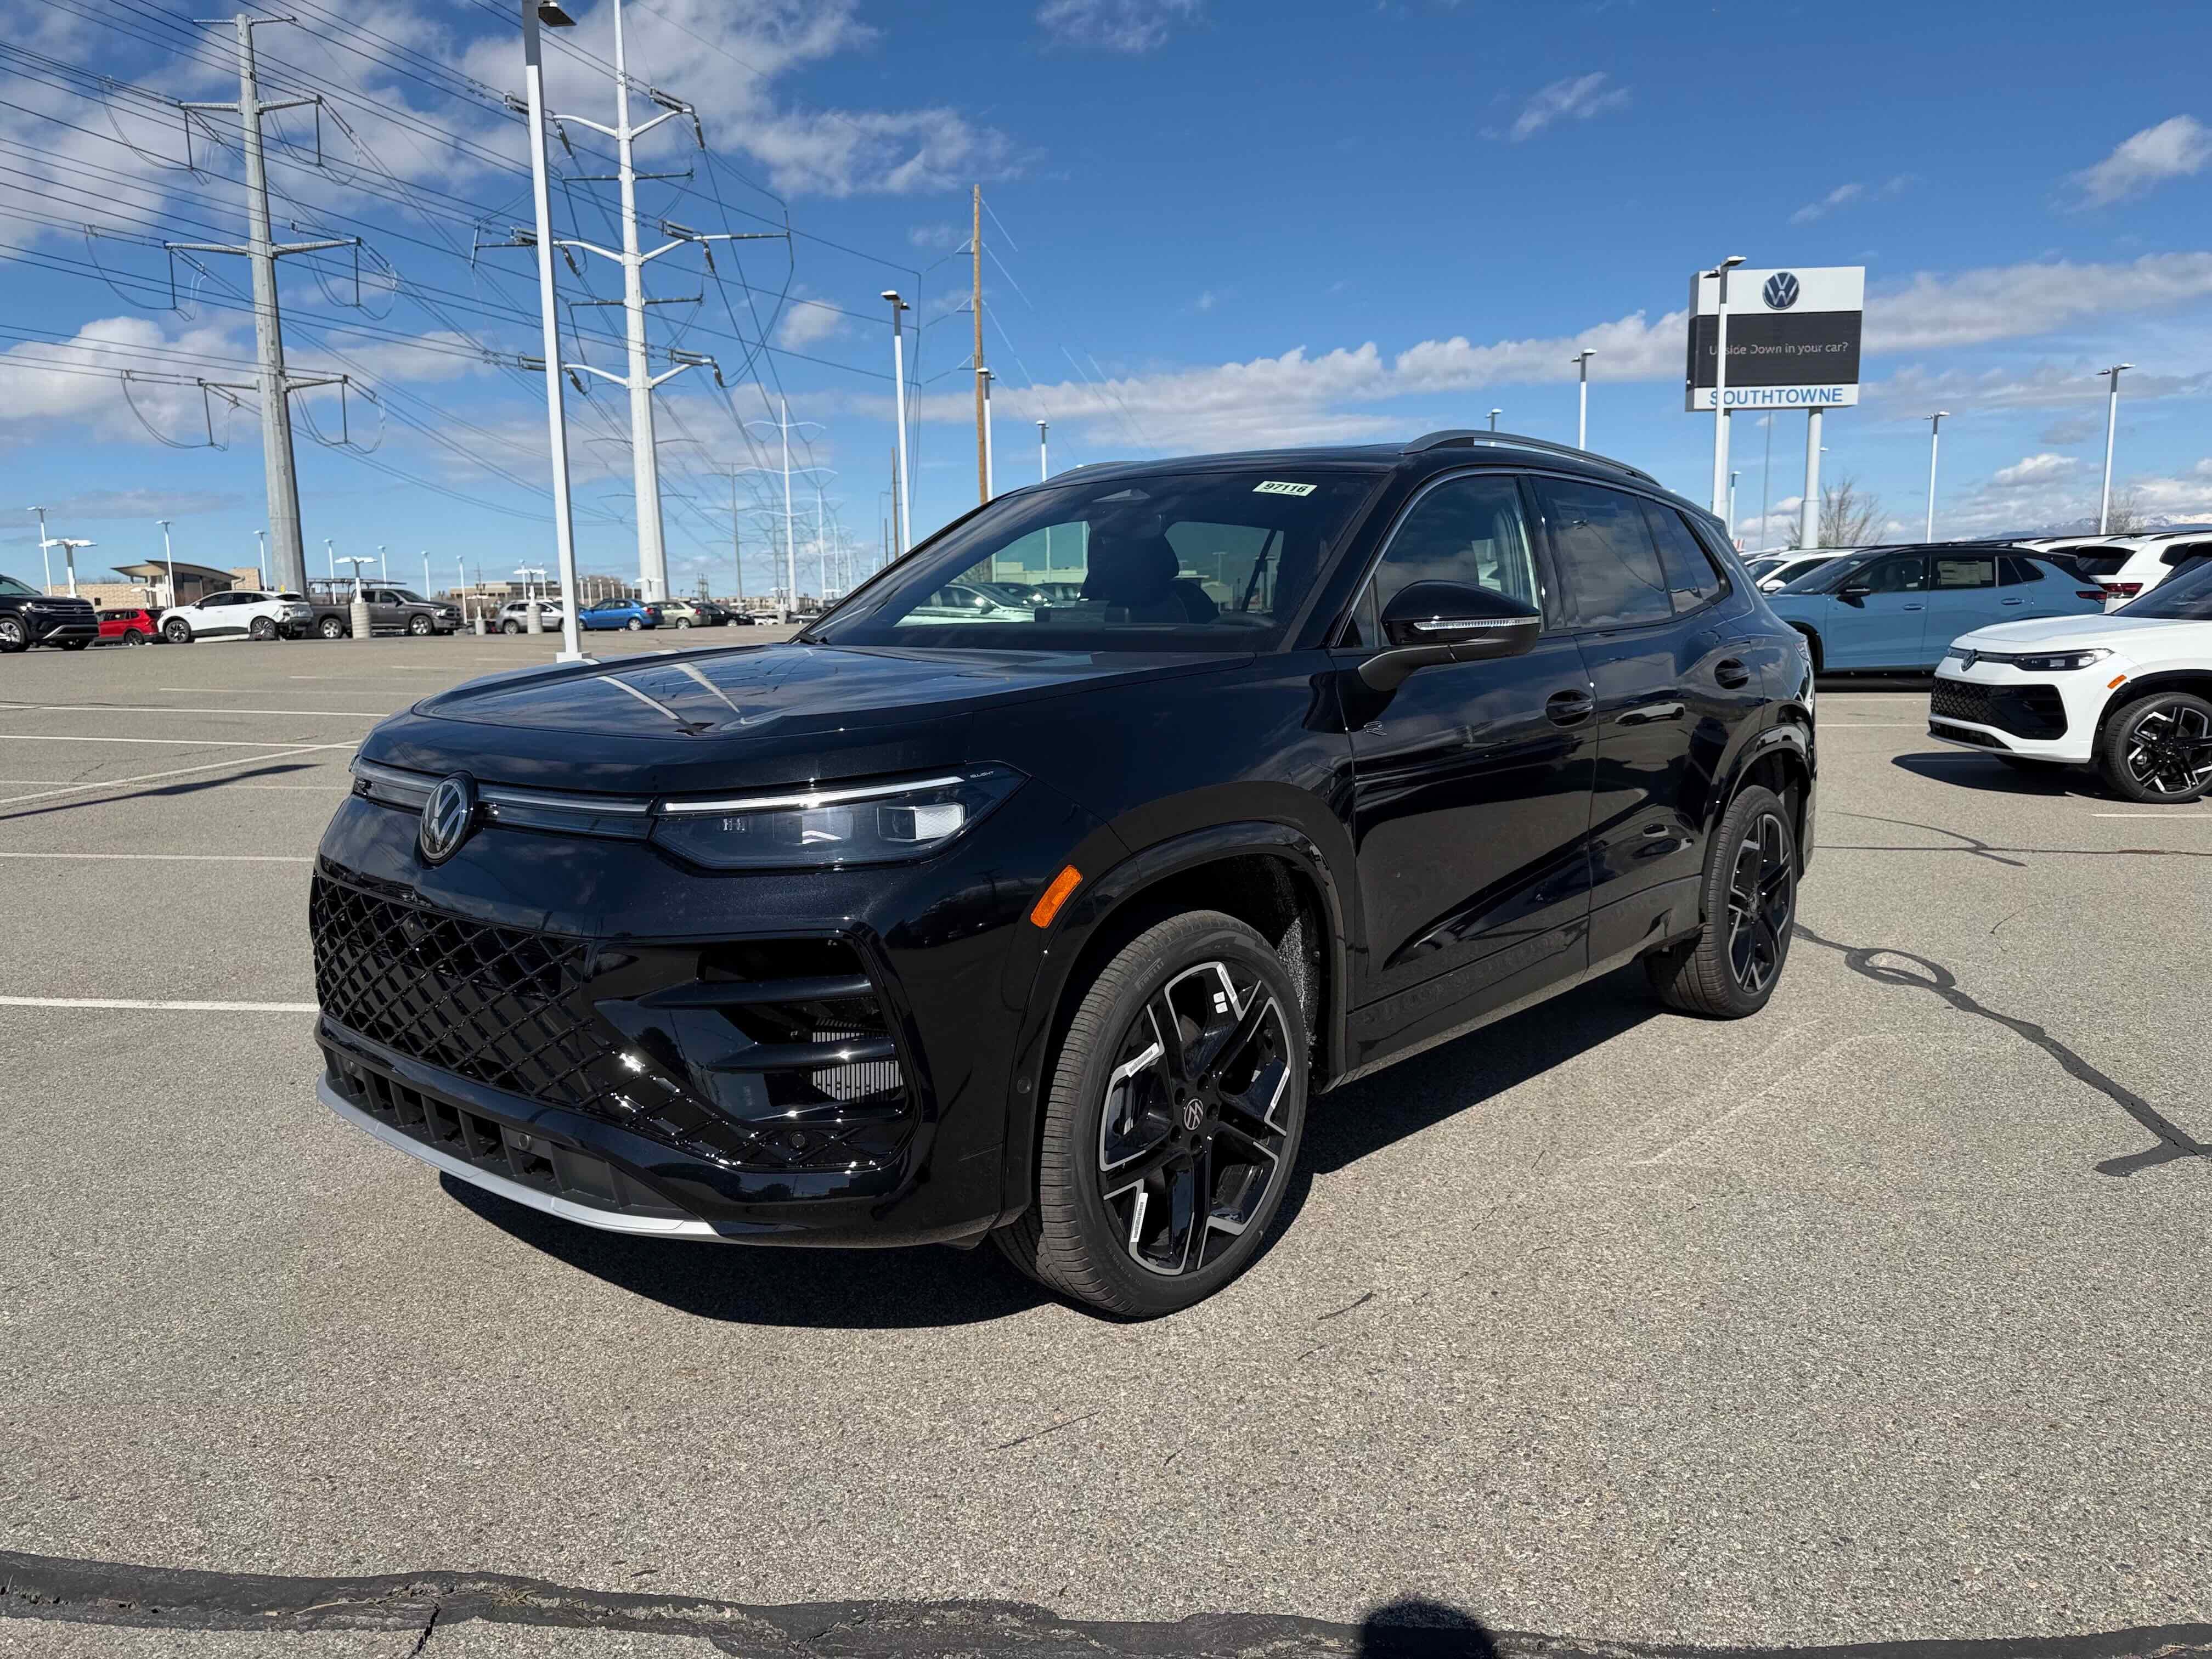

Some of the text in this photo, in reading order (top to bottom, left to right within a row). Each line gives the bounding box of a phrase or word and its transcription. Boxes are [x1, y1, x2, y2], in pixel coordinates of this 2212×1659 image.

[1709, 343, 1747, 355] Uside
[1785, 342, 1796, 353] in
[1797, 343, 1822, 356] your
[1825, 341, 1849, 353] car?
[1709, 387, 1843, 405] SOUTHTOWNE
[1263, 483, 1309, 493] 97116
